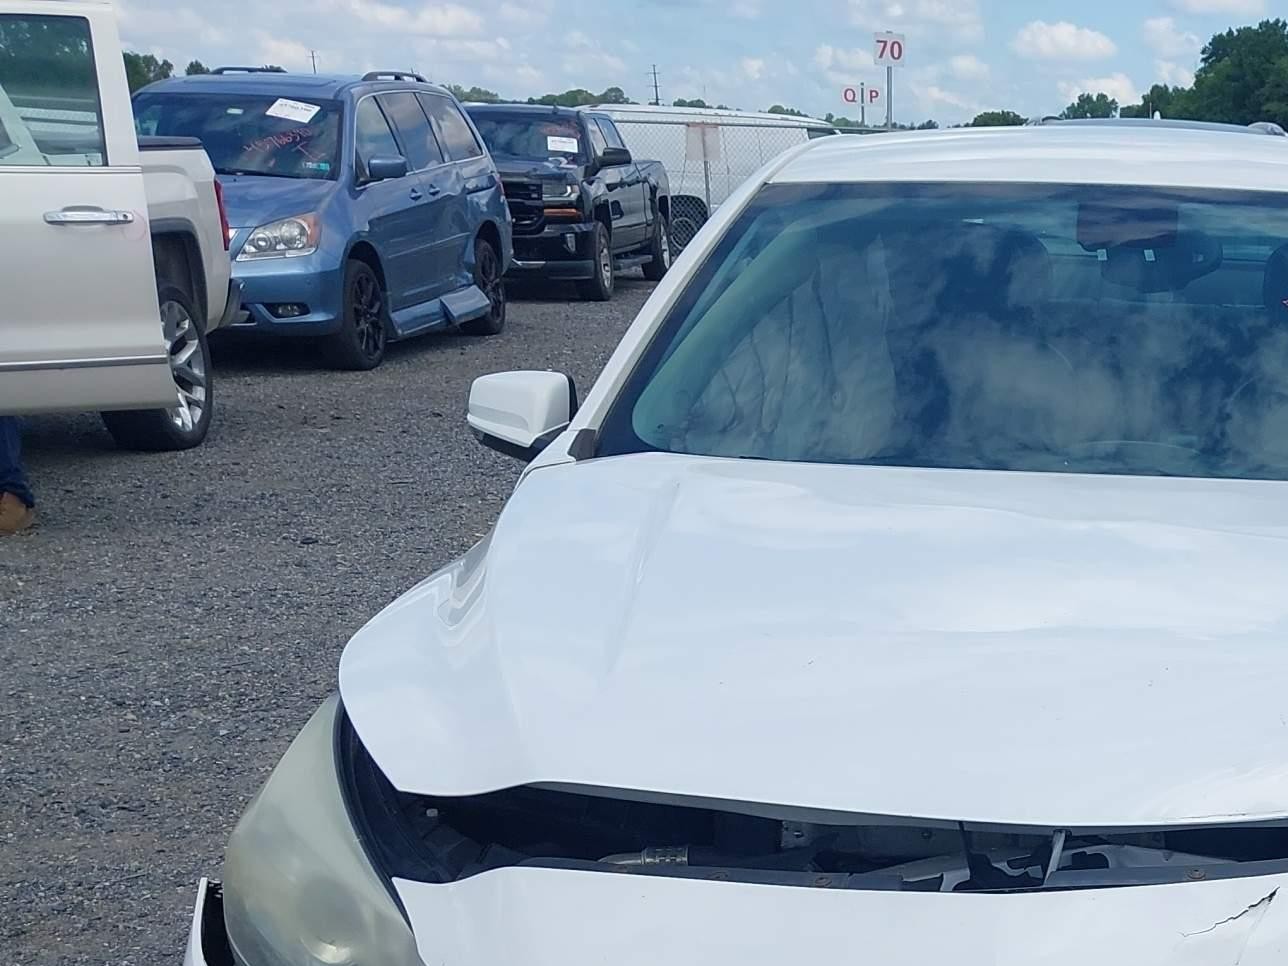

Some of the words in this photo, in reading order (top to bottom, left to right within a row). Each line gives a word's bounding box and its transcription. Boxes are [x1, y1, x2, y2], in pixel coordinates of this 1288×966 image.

[875, 39, 903, 60] 70
[843, 88, 857, 103] Q
[869, 89, 879, 104] P
